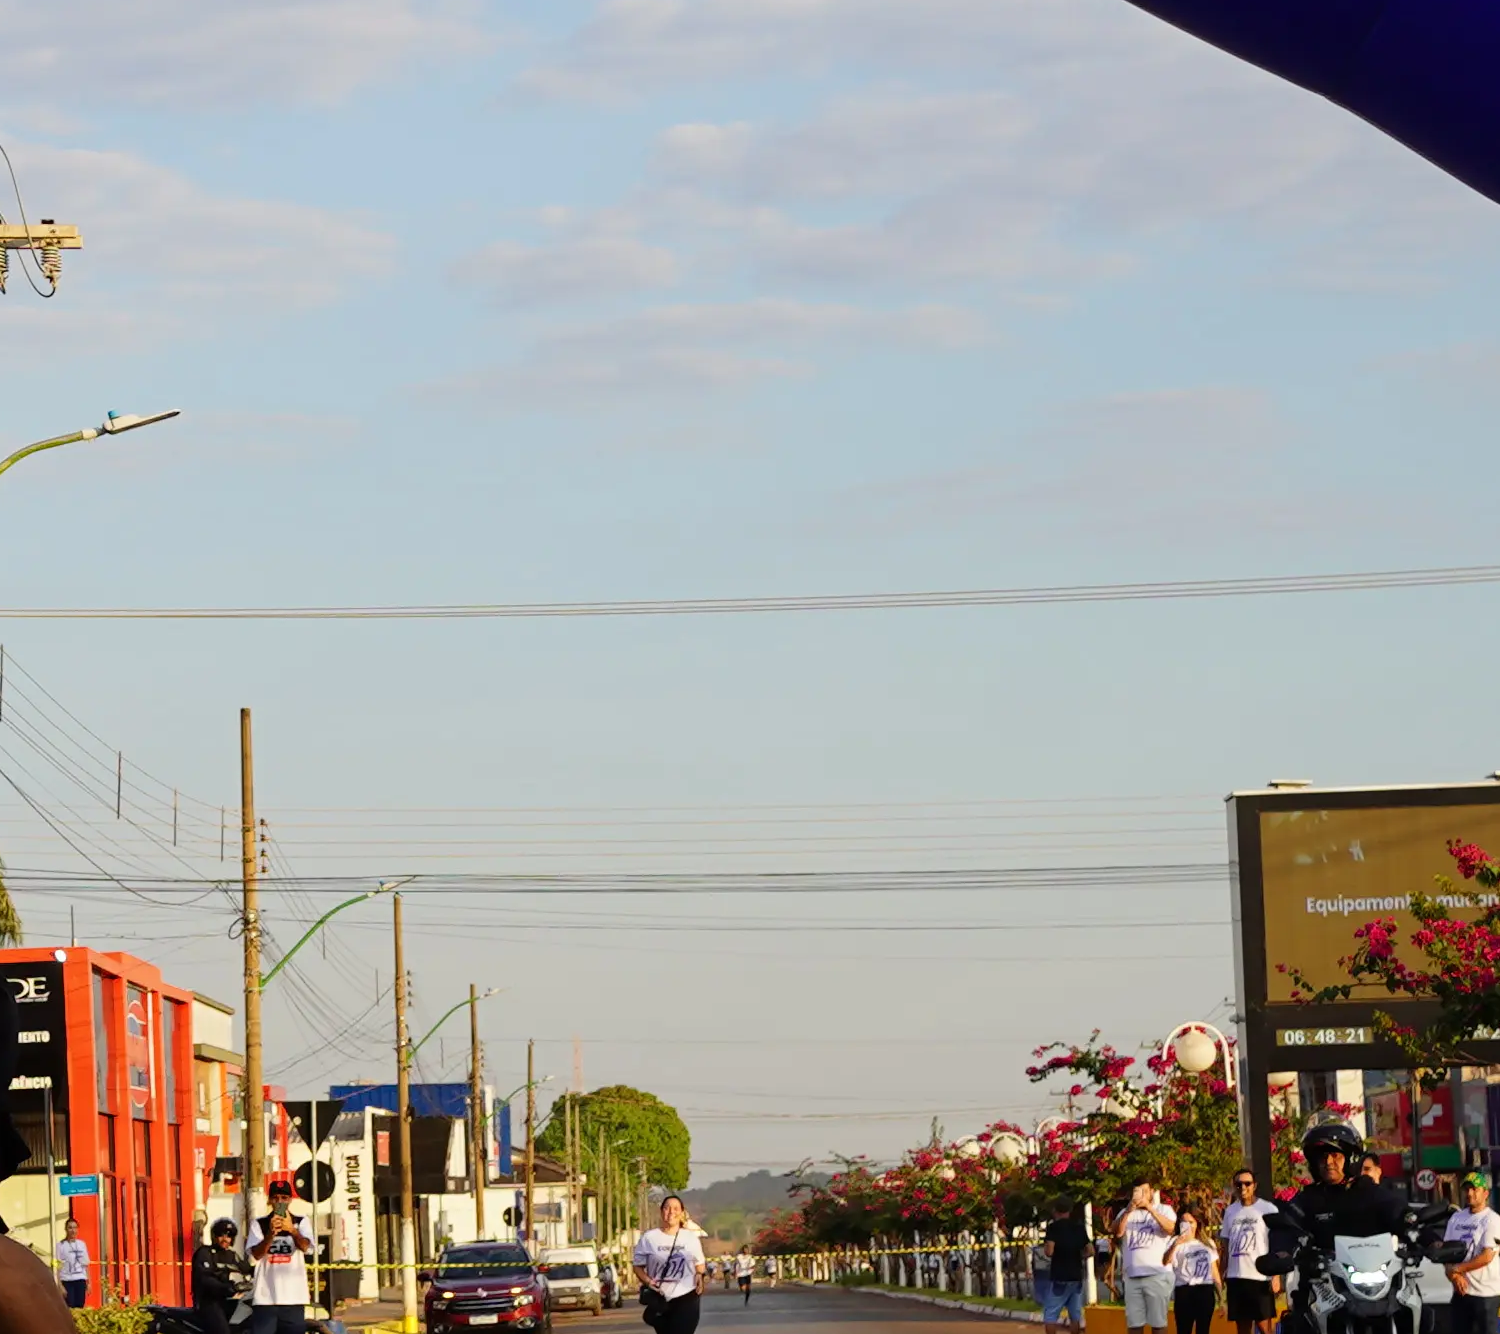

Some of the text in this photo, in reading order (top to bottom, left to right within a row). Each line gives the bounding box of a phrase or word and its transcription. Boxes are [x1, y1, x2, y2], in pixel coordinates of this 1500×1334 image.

[1284, 1028, 1365, 1045] 06:48:21
[345, 1154, 361, 1194] ÓPTICA
[1419, 1174, 1434, 1185] 40
